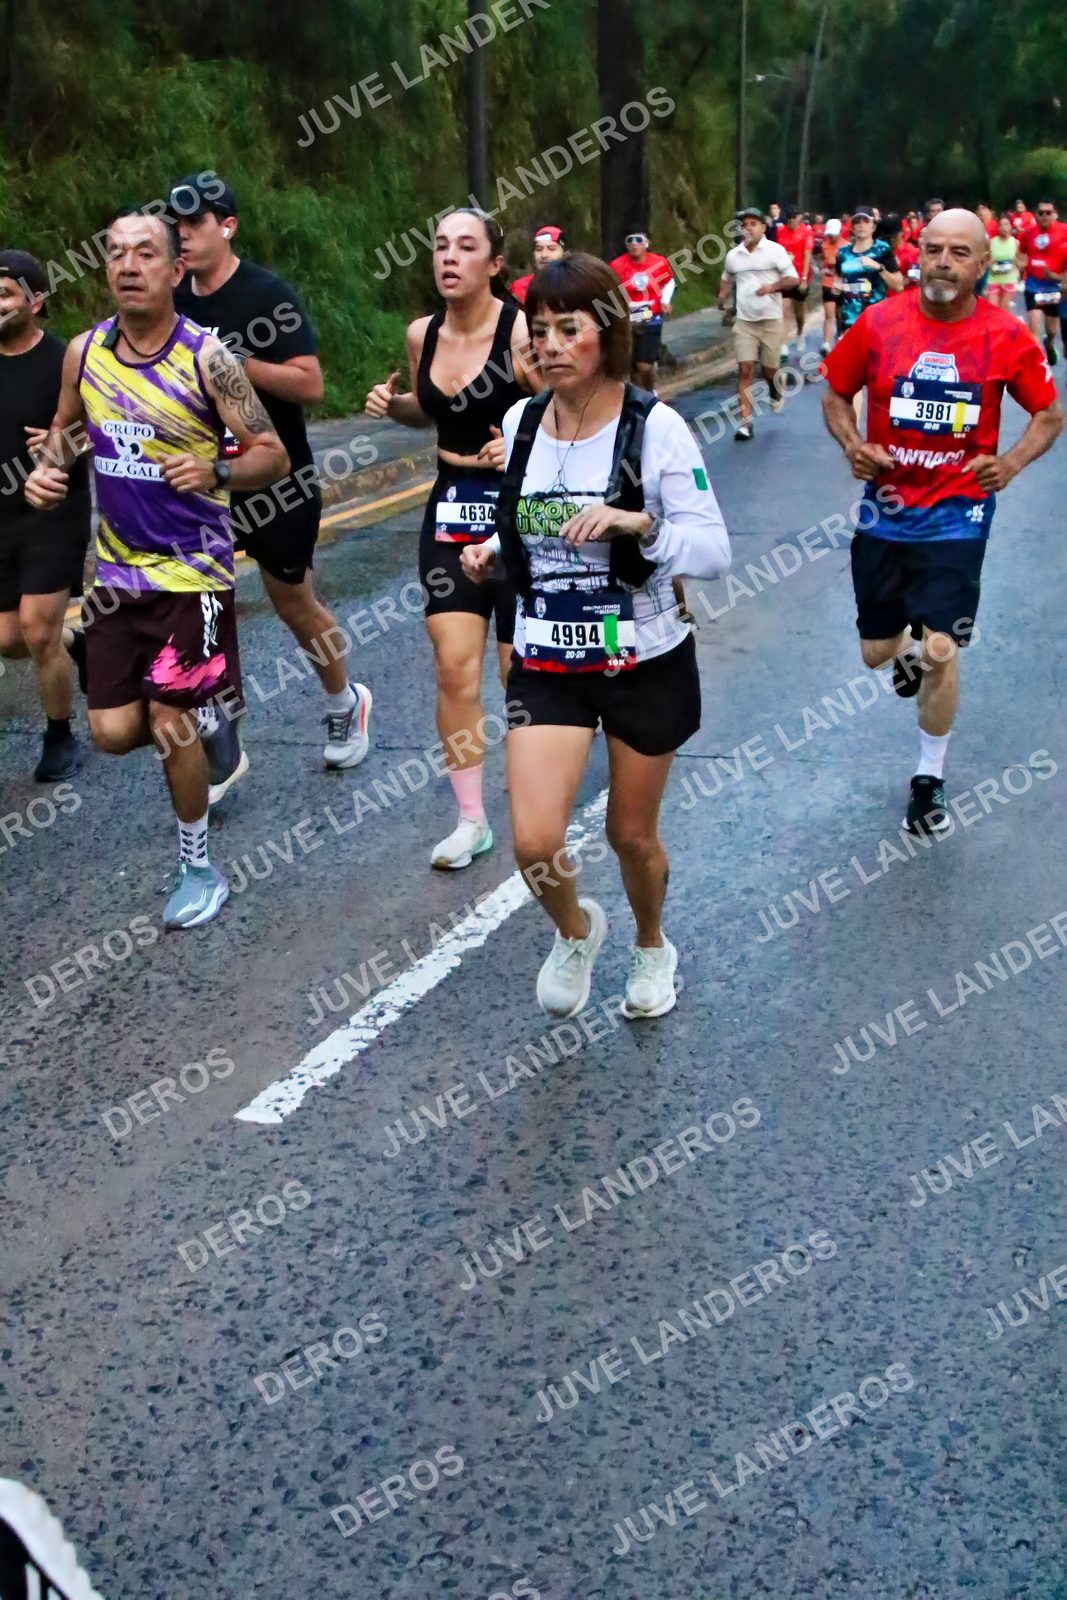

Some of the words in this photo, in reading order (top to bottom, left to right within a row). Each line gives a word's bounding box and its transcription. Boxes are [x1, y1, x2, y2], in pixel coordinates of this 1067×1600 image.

[916, 402, 951, 421] 3981
[104, 423, 151, 437] GRUPO
[460, 505, 495, 522] 4634
[551, 624, 600, 646] 4994
